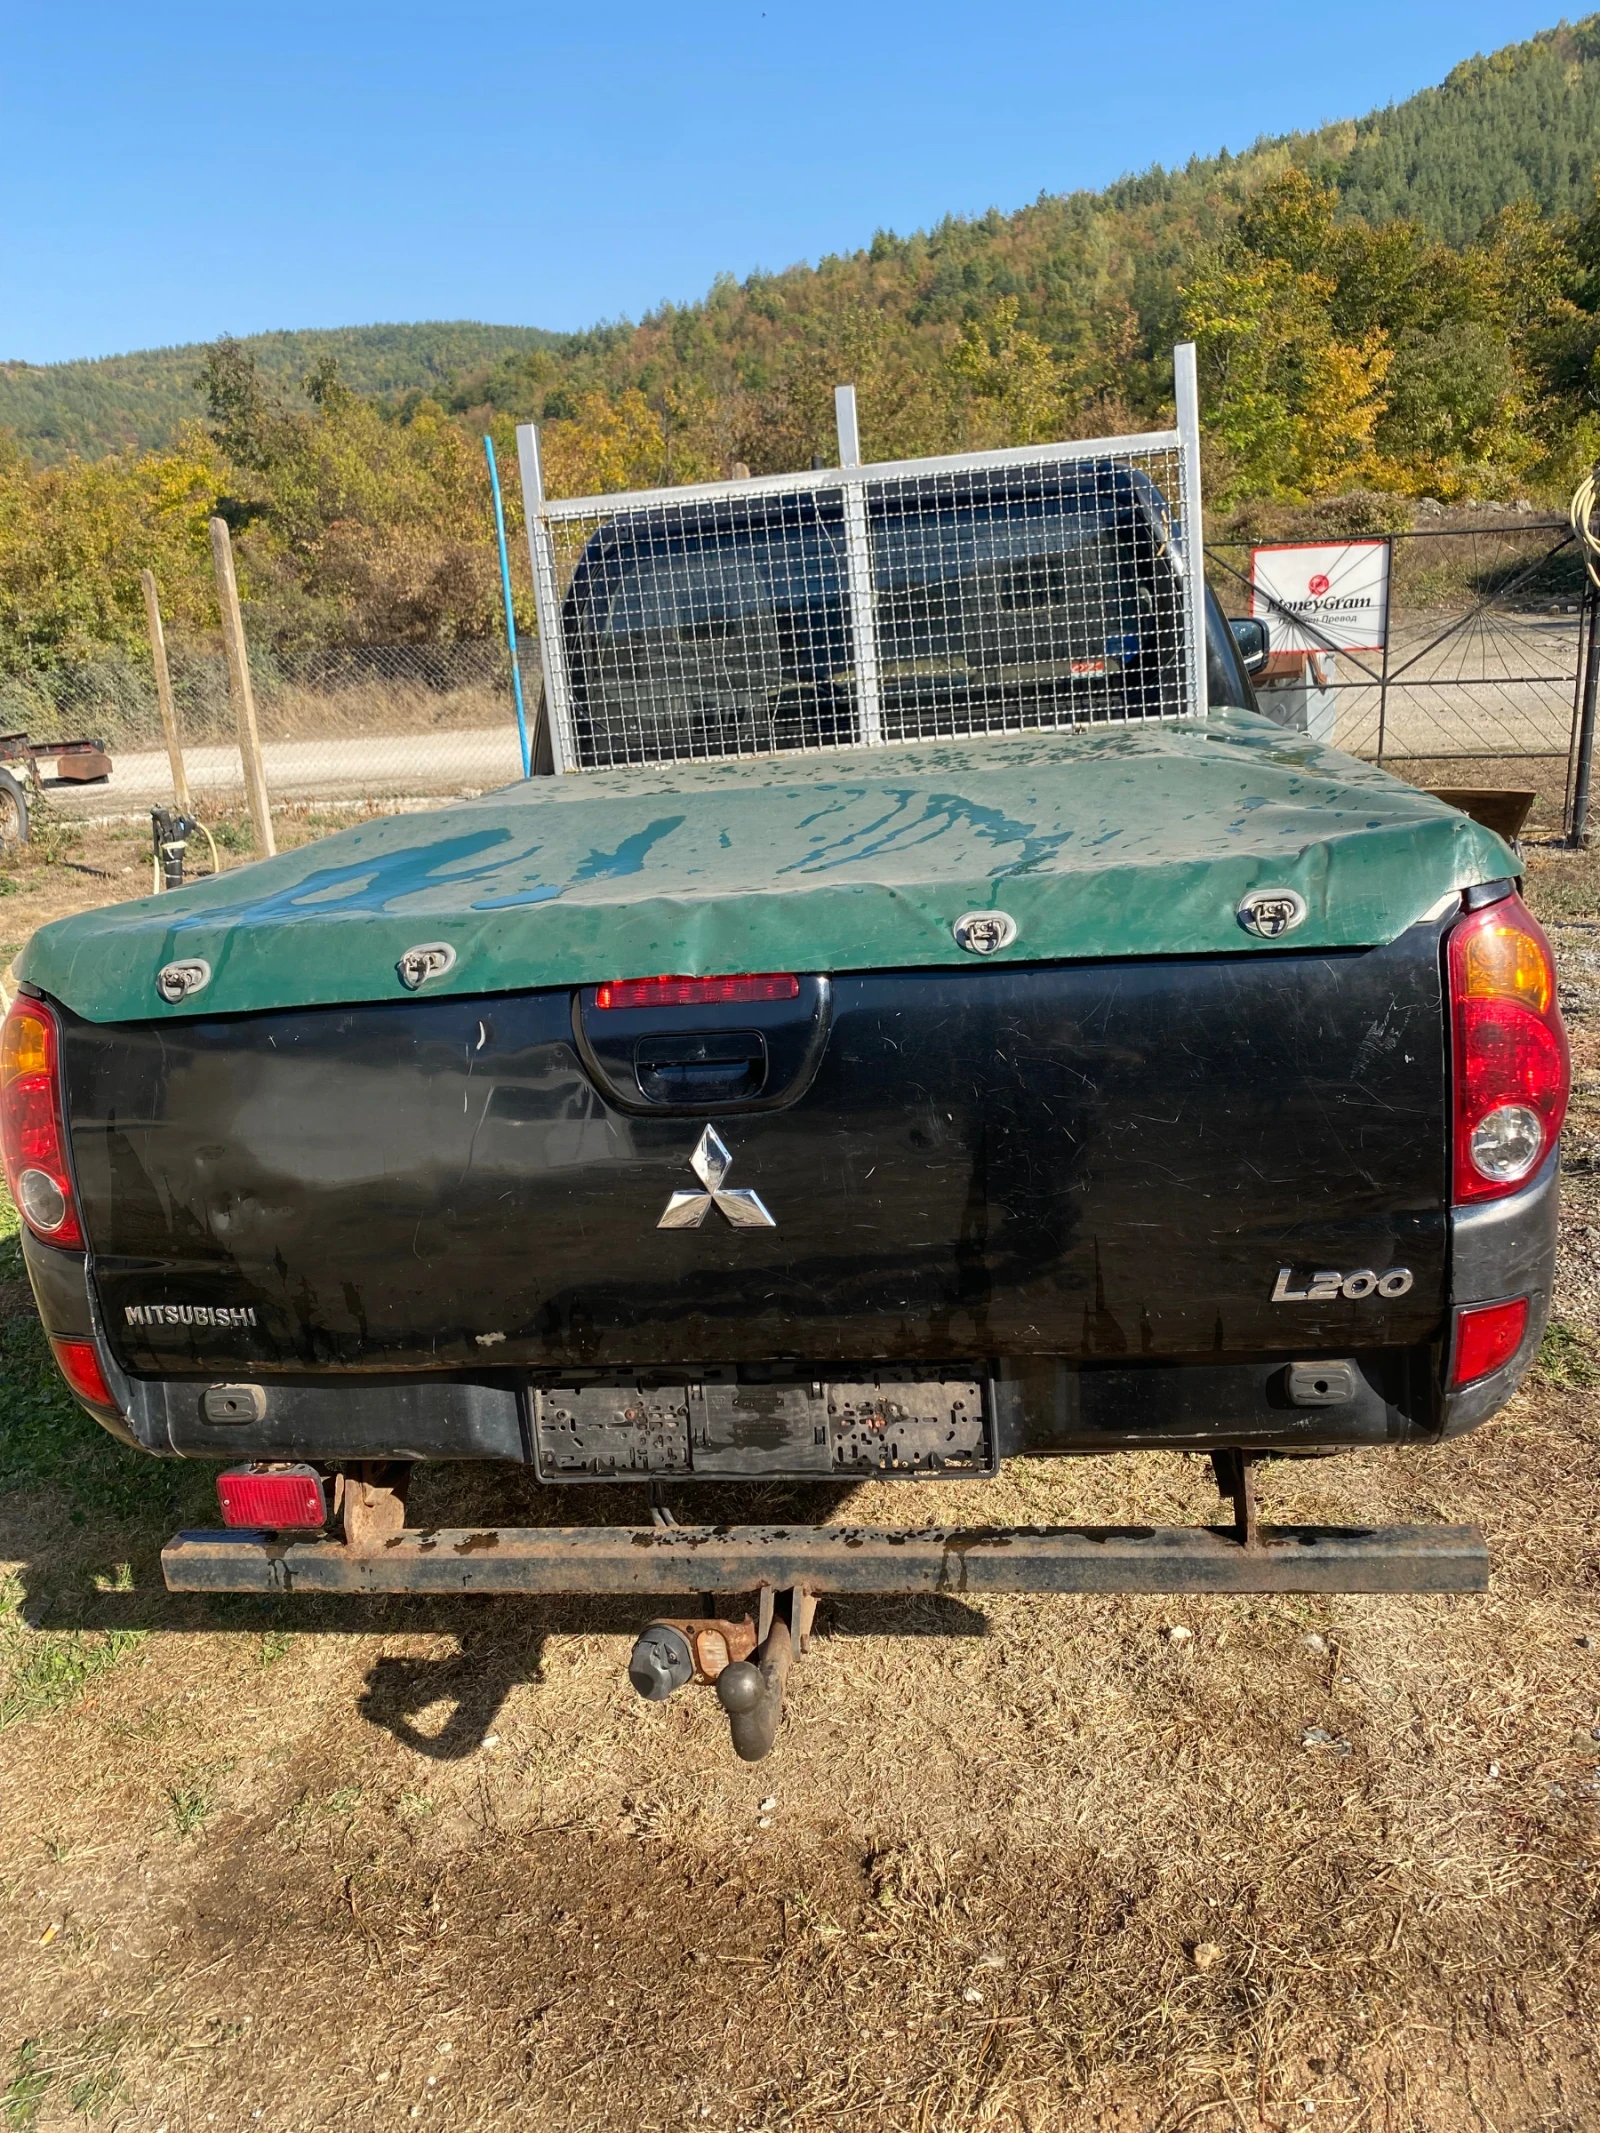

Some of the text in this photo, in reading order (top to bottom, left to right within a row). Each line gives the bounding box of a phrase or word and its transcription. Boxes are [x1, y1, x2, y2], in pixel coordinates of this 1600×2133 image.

[1267, 596, 1371, 613] MoneyGram
[1322, 615, 1357, 624] Превод
[1271, 1268, 1413, 1302] L200
[124, 1305, 257, 1327] MITSUBISHI
